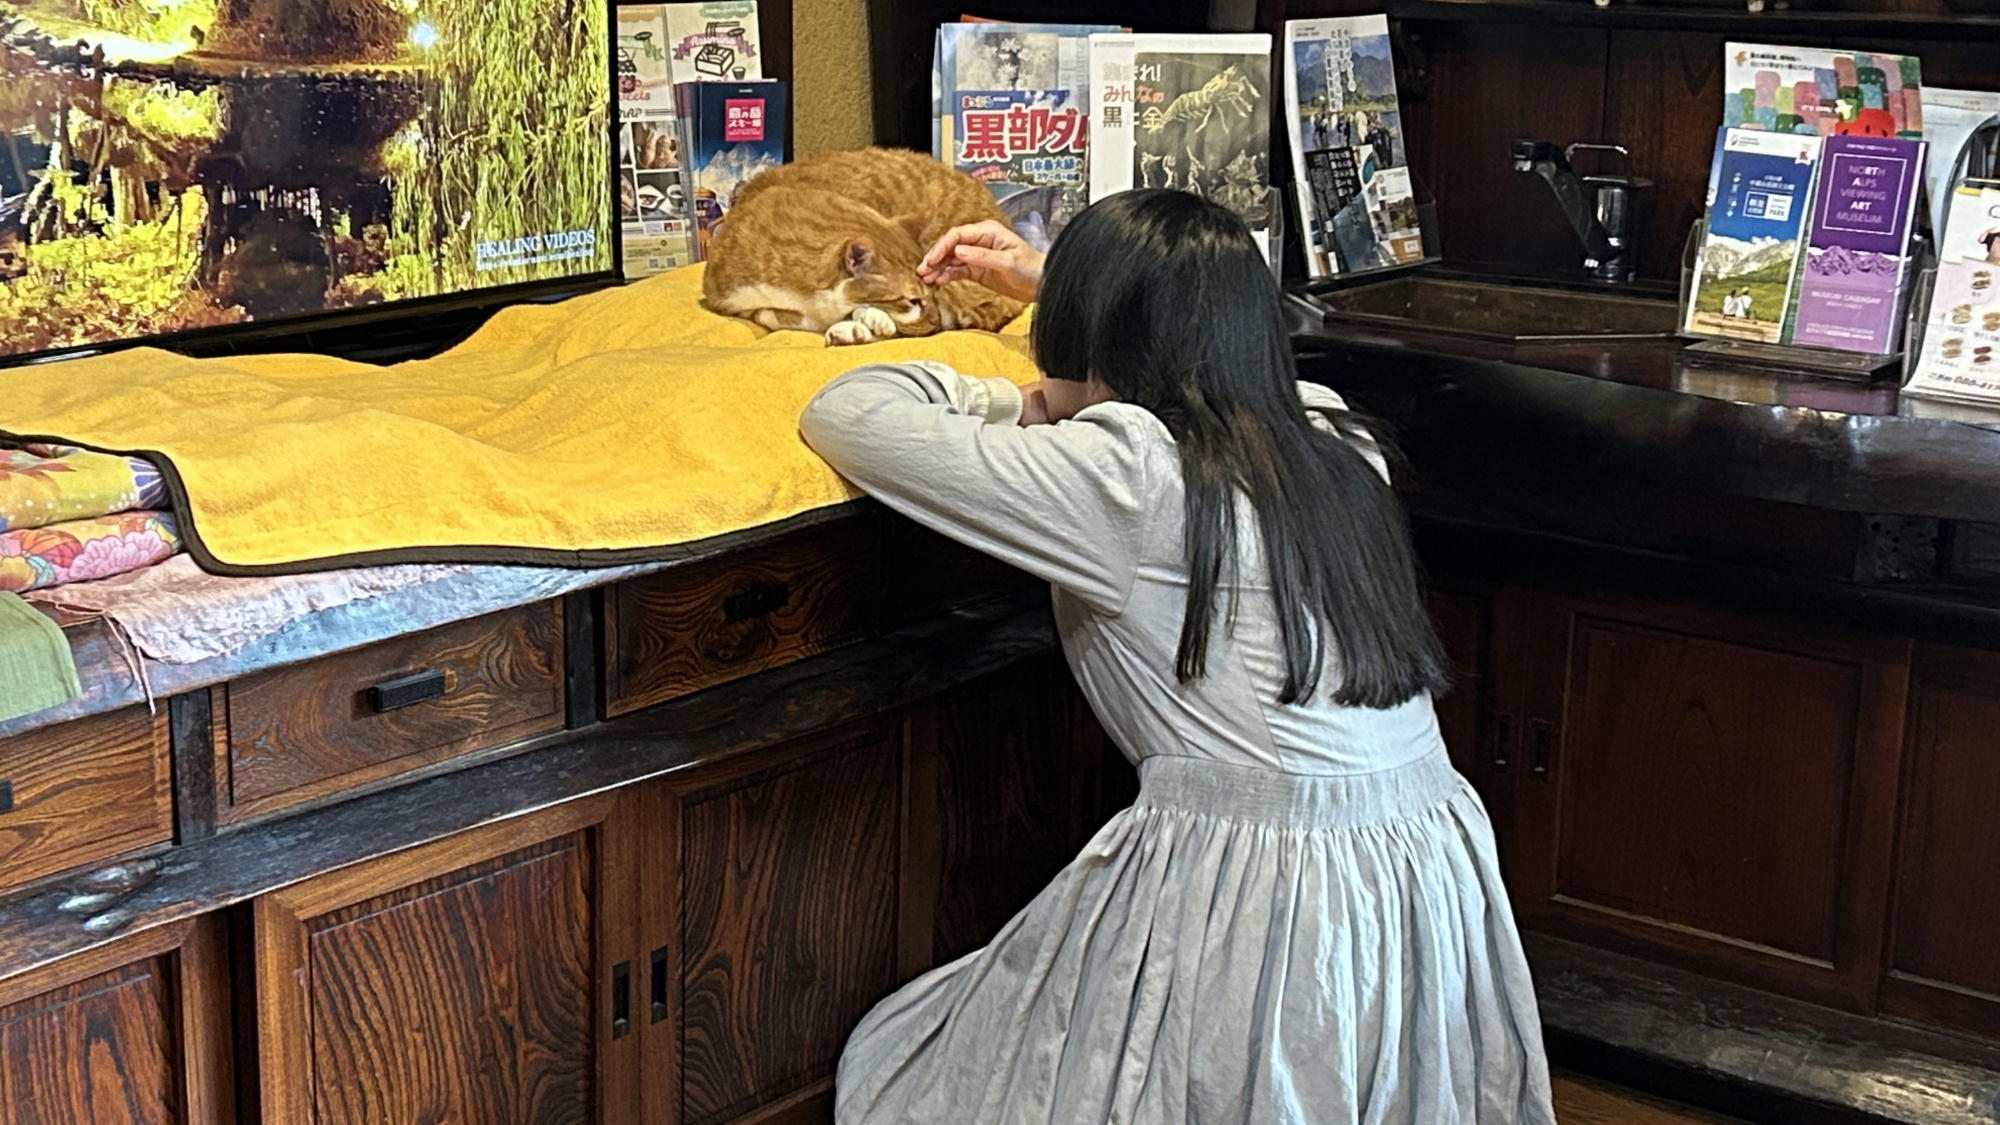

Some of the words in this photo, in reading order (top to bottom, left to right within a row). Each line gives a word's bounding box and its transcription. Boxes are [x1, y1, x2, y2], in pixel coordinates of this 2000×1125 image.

[1848, 165, 1886, 176] NORTH
[1852, 177, 1877, 188] ALPS
[1840, 189, 1886, 201] VIEWING
[1850, 201, 1872, 211] ART
[1836, 212, 1882, 223] MUSEUM
[476, 235, 541, 258] HEALING
[543, 229, 595, 250] VIDEOS
